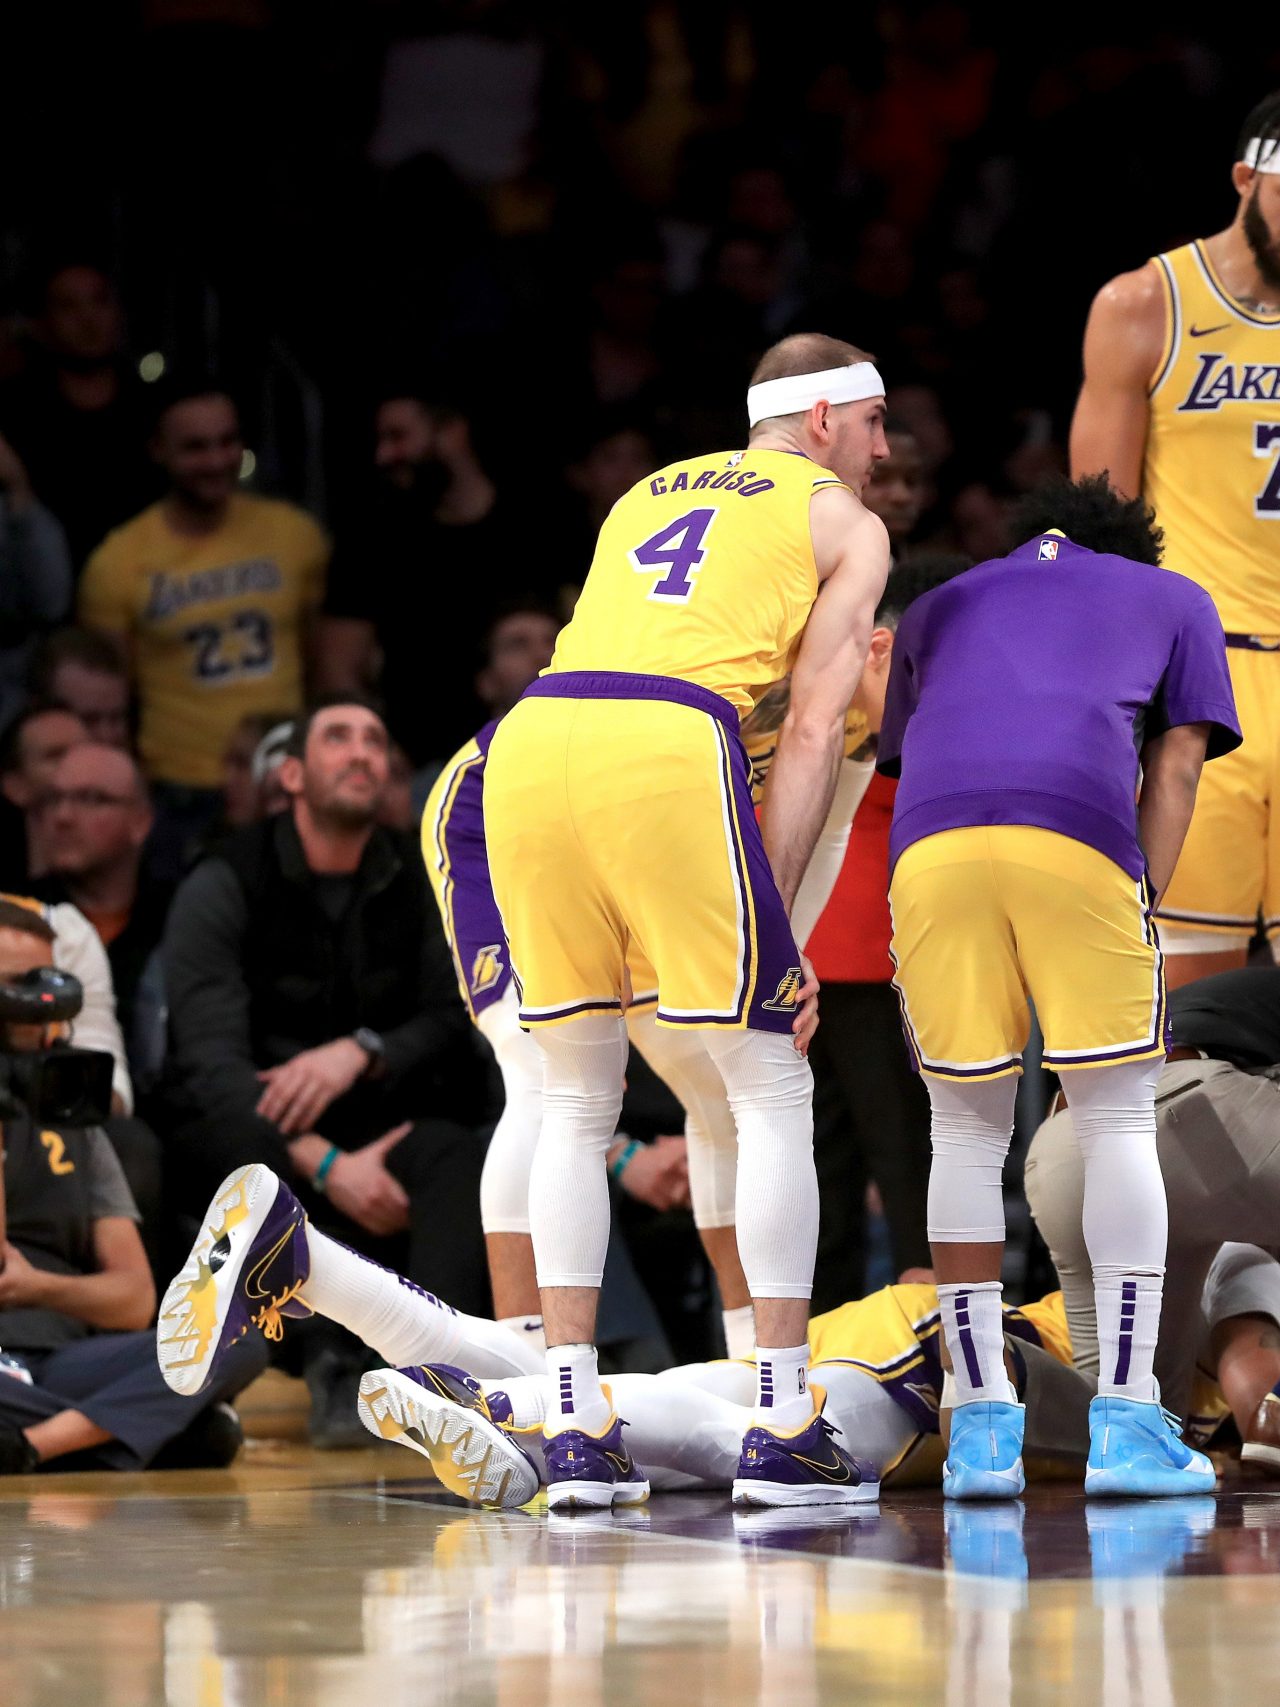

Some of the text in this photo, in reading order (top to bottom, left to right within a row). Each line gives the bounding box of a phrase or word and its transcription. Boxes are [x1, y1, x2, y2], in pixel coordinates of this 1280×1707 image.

[650, 470, 775, 496] CARUSO
[627, 507, 719, 604] 4
[184, 608, 276, 684] 23
[40, 1129, 76, 1176] 2
[567, 1450, 574, 1461] 8
[746, 1448, 757, 1460] 24
